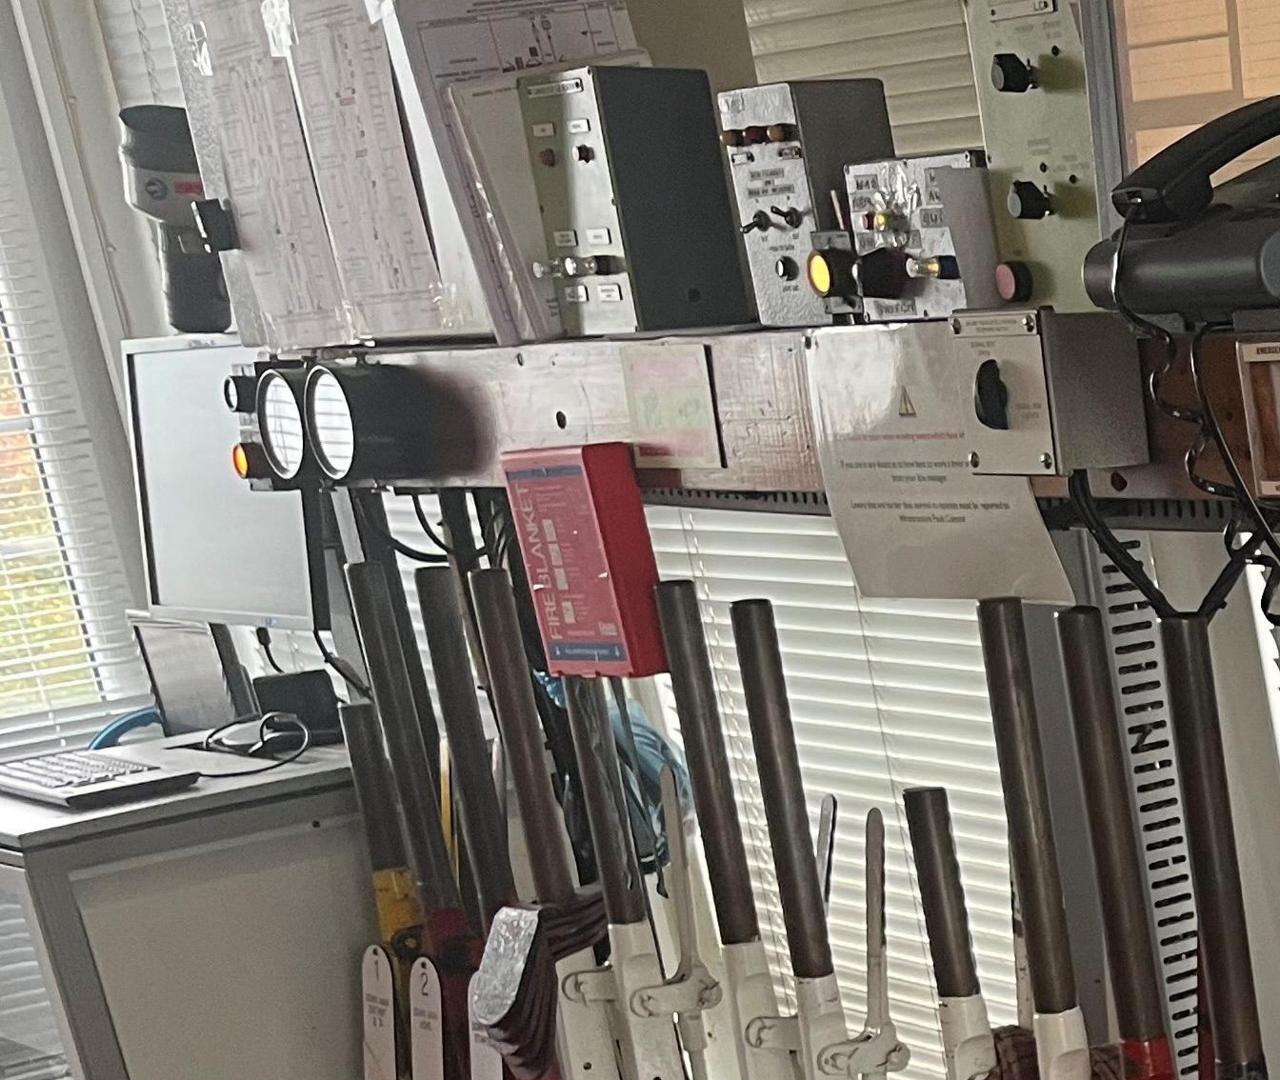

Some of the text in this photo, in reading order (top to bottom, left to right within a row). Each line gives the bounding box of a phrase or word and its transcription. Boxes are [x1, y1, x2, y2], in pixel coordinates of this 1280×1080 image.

[516, 484, 563, 640] FIRE BLANKET
[420, 972, 429, 996] 2
